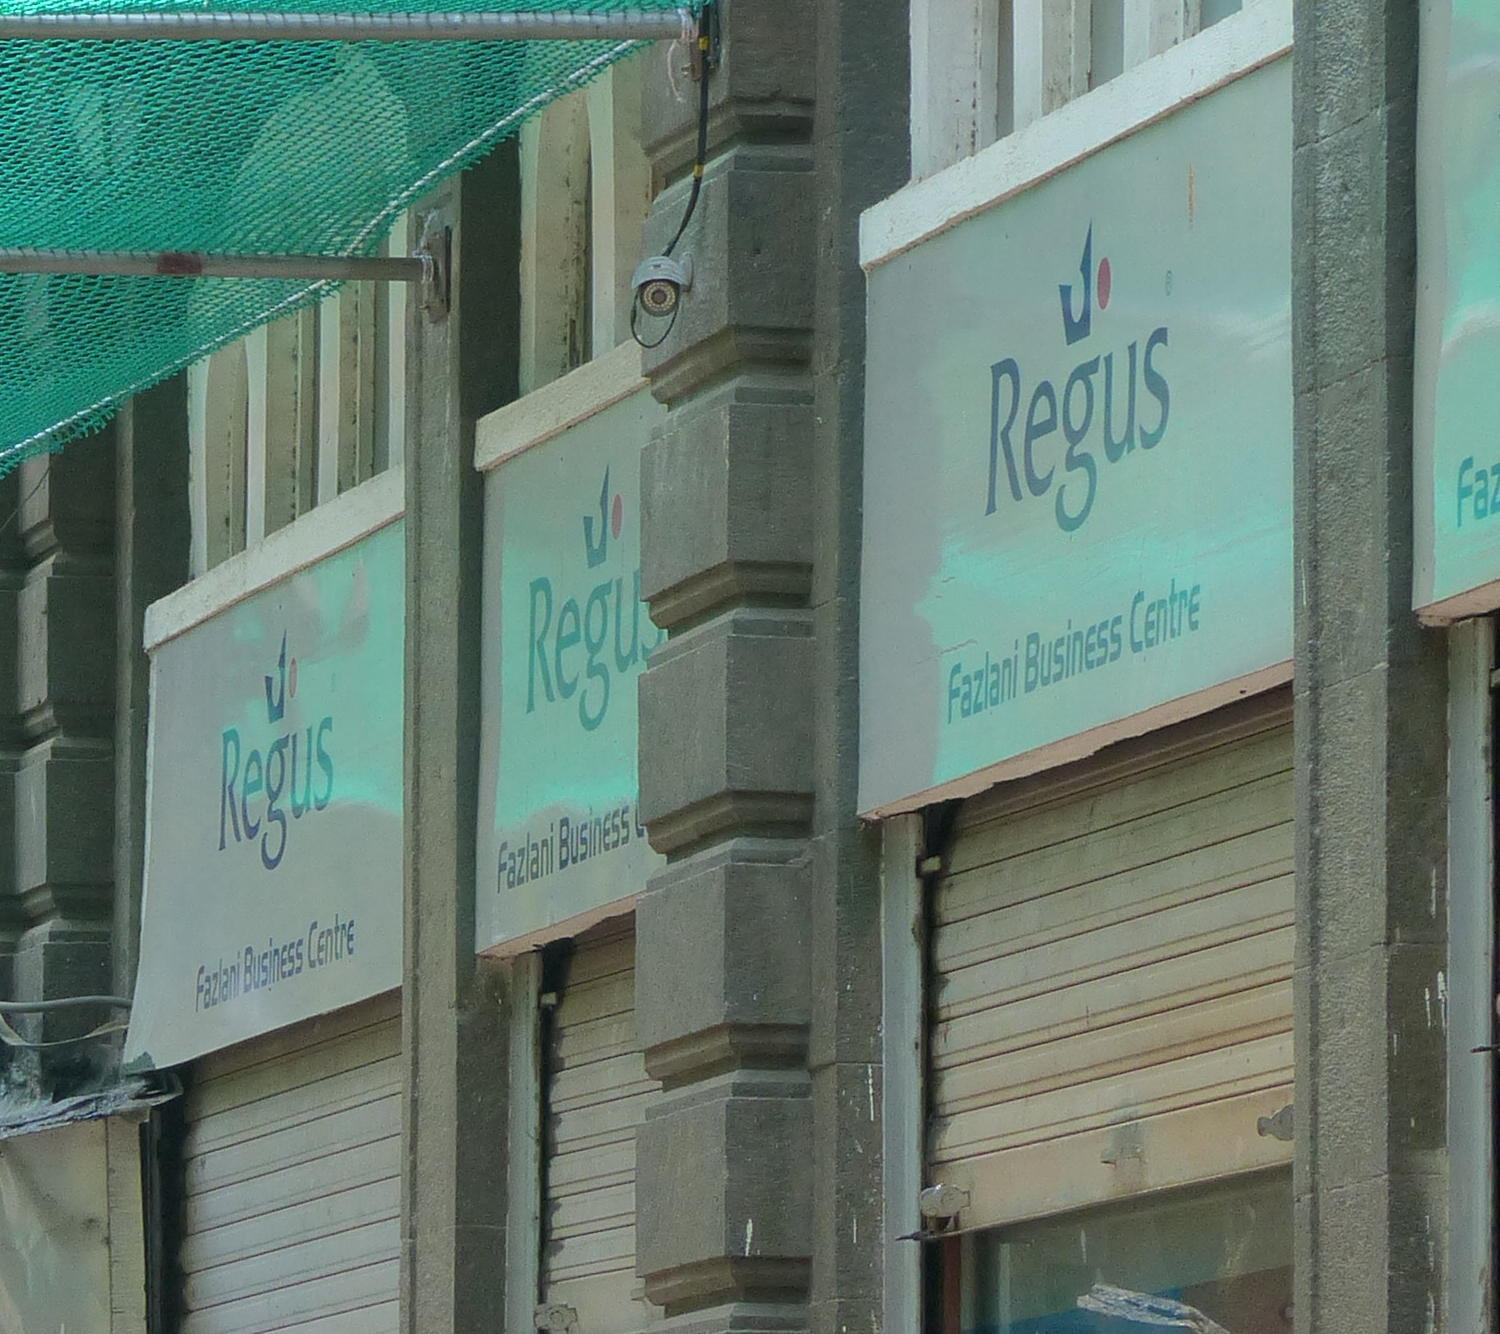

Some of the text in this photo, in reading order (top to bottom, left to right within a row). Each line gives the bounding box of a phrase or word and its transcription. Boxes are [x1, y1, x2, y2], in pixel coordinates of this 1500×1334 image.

[985, 327, 1170, 532] Regus
[526, 568, 663, 731] Regu
[947, 578, 1200, 724] Fazlani Business Centre
[219, 717, 333, 870] Regus
[497, 822, 553, 894] Fazlani
[559, 805, 629, 870] Business
[196, 913, 355, 1012] Fazlani Business Centre
